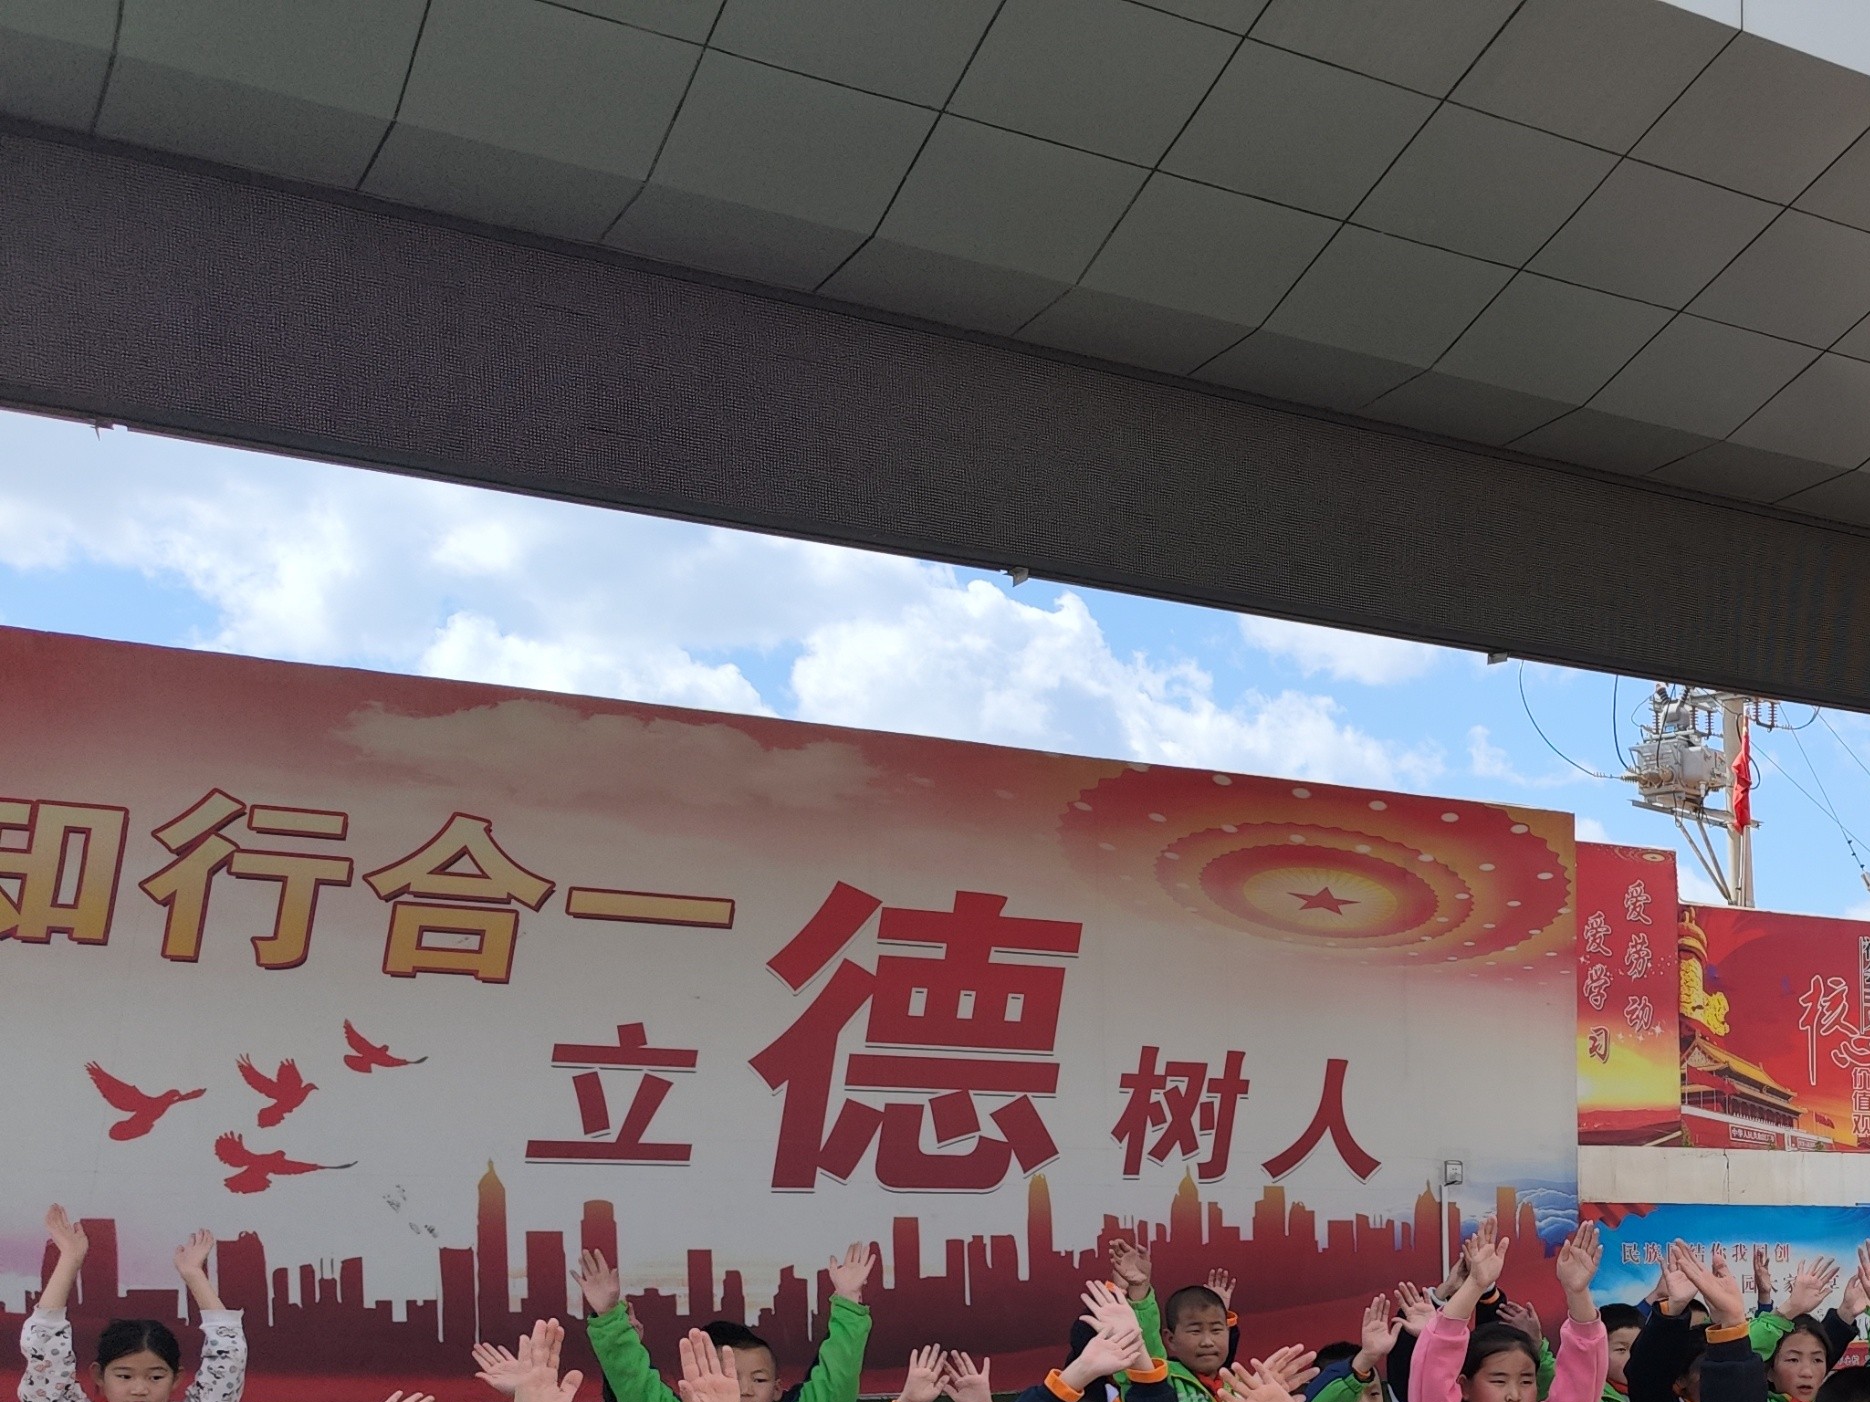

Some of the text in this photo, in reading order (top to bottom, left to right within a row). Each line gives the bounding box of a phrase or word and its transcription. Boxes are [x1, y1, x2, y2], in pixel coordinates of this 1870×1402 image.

[1583, 910, 1613, 1064] 爱学习
[1624, 879, 1653, 1033] 爱劳动
[526, 881, 1382, 1195] 立德树人
